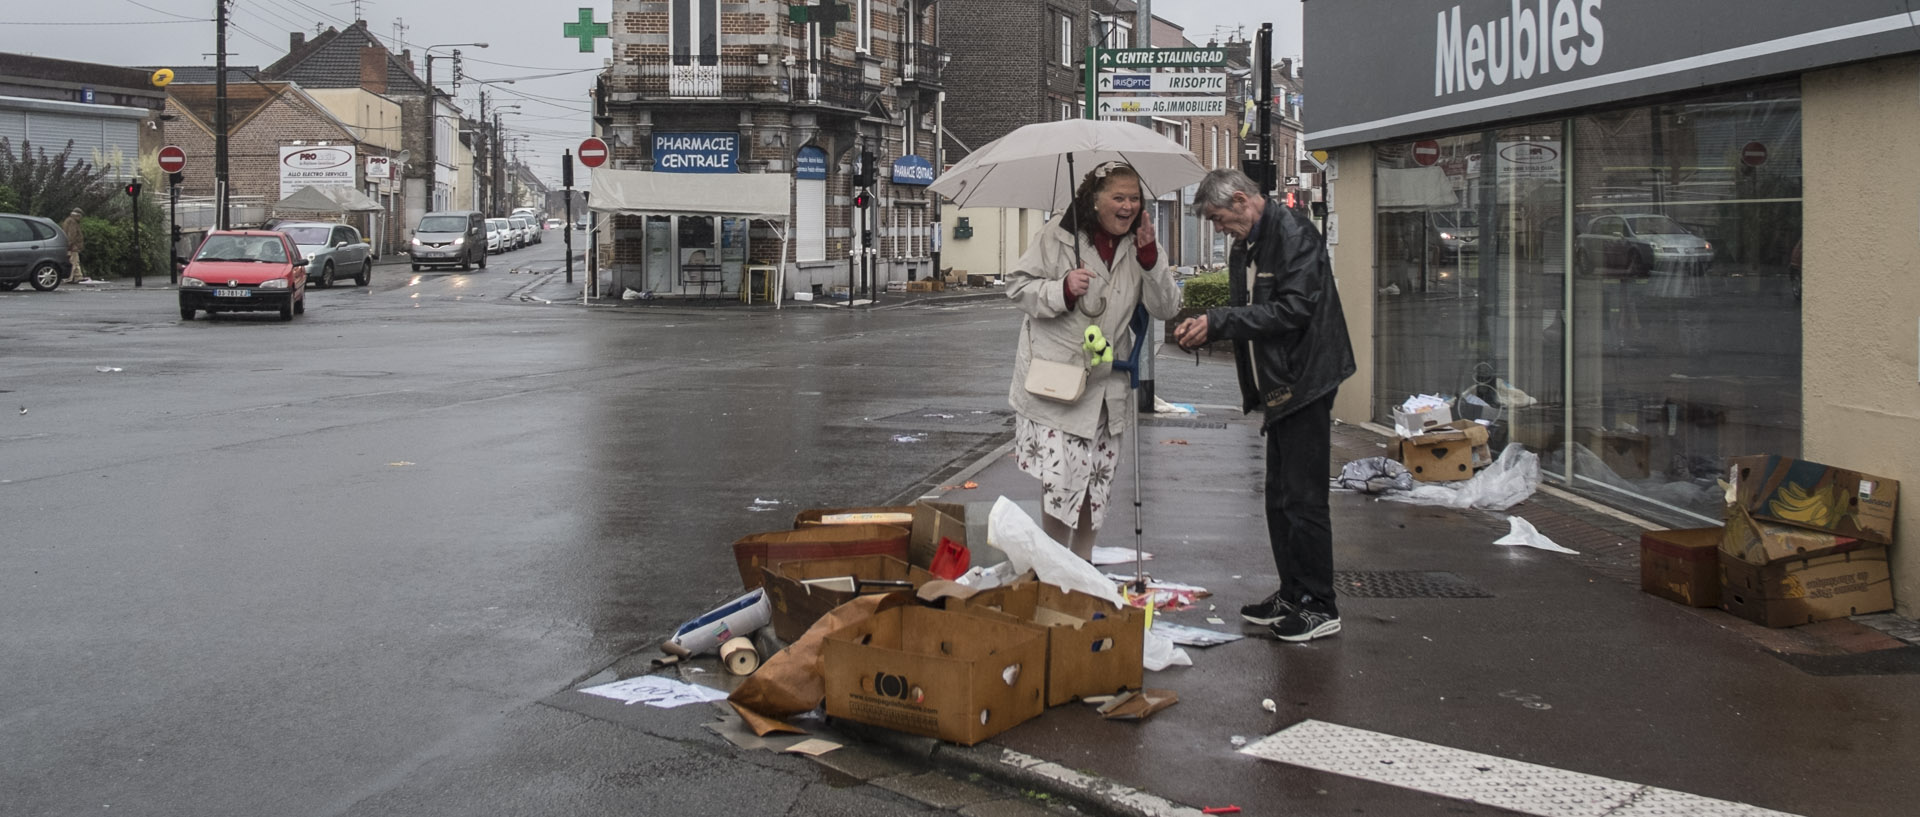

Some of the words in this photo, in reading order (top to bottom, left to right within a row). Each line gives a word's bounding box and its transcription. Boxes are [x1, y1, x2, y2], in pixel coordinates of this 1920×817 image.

[1435, 0, 1604, 97] Meubles
[1115, 51, 1155, 64] CENTRE
[1157, 50, 1223, 63] STALINGRAD
[1113, 78, 1150, 88] IRISOPTIC
[1169, 77, 1223, 88] IRISOPTIC
[1152, 101, 1222, 112] AG.IMMOBILIERE
[656, 137, 734, 151] PHARMACIE
[661, 154, 729, 168] CENTRALE
[894, 164, 915, 180] PHARMACIE
[915, 166, 933, 180] CENTRALE
